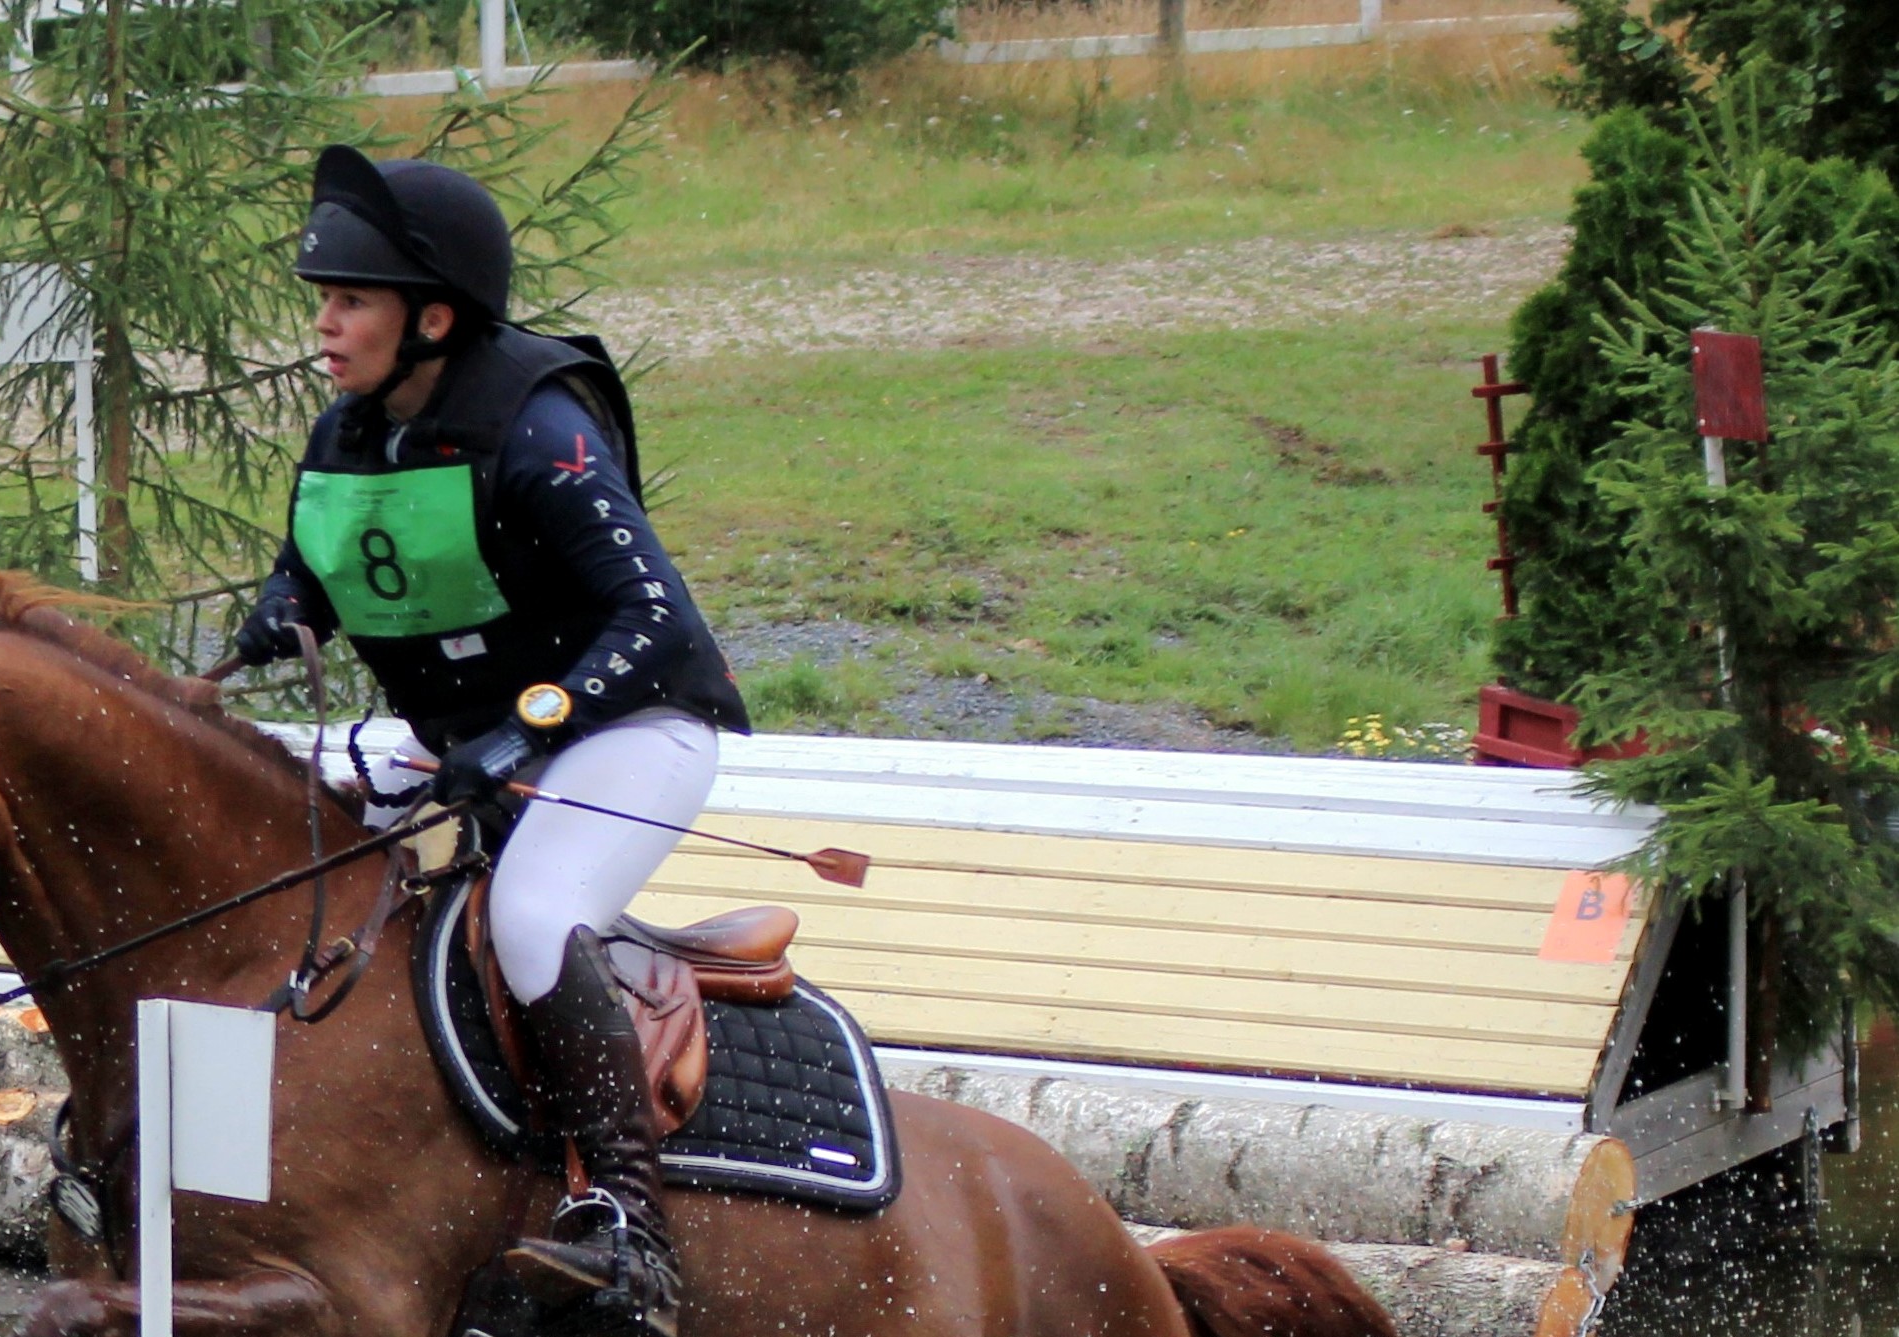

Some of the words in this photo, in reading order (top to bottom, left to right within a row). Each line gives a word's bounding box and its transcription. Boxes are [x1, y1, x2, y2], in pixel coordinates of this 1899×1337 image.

[359, 528, 408, 601] 8
[592, 498, 669, 623] POINT
[584, 633, 652, 695] TWO
[1575, 888, 1605, 921] B
